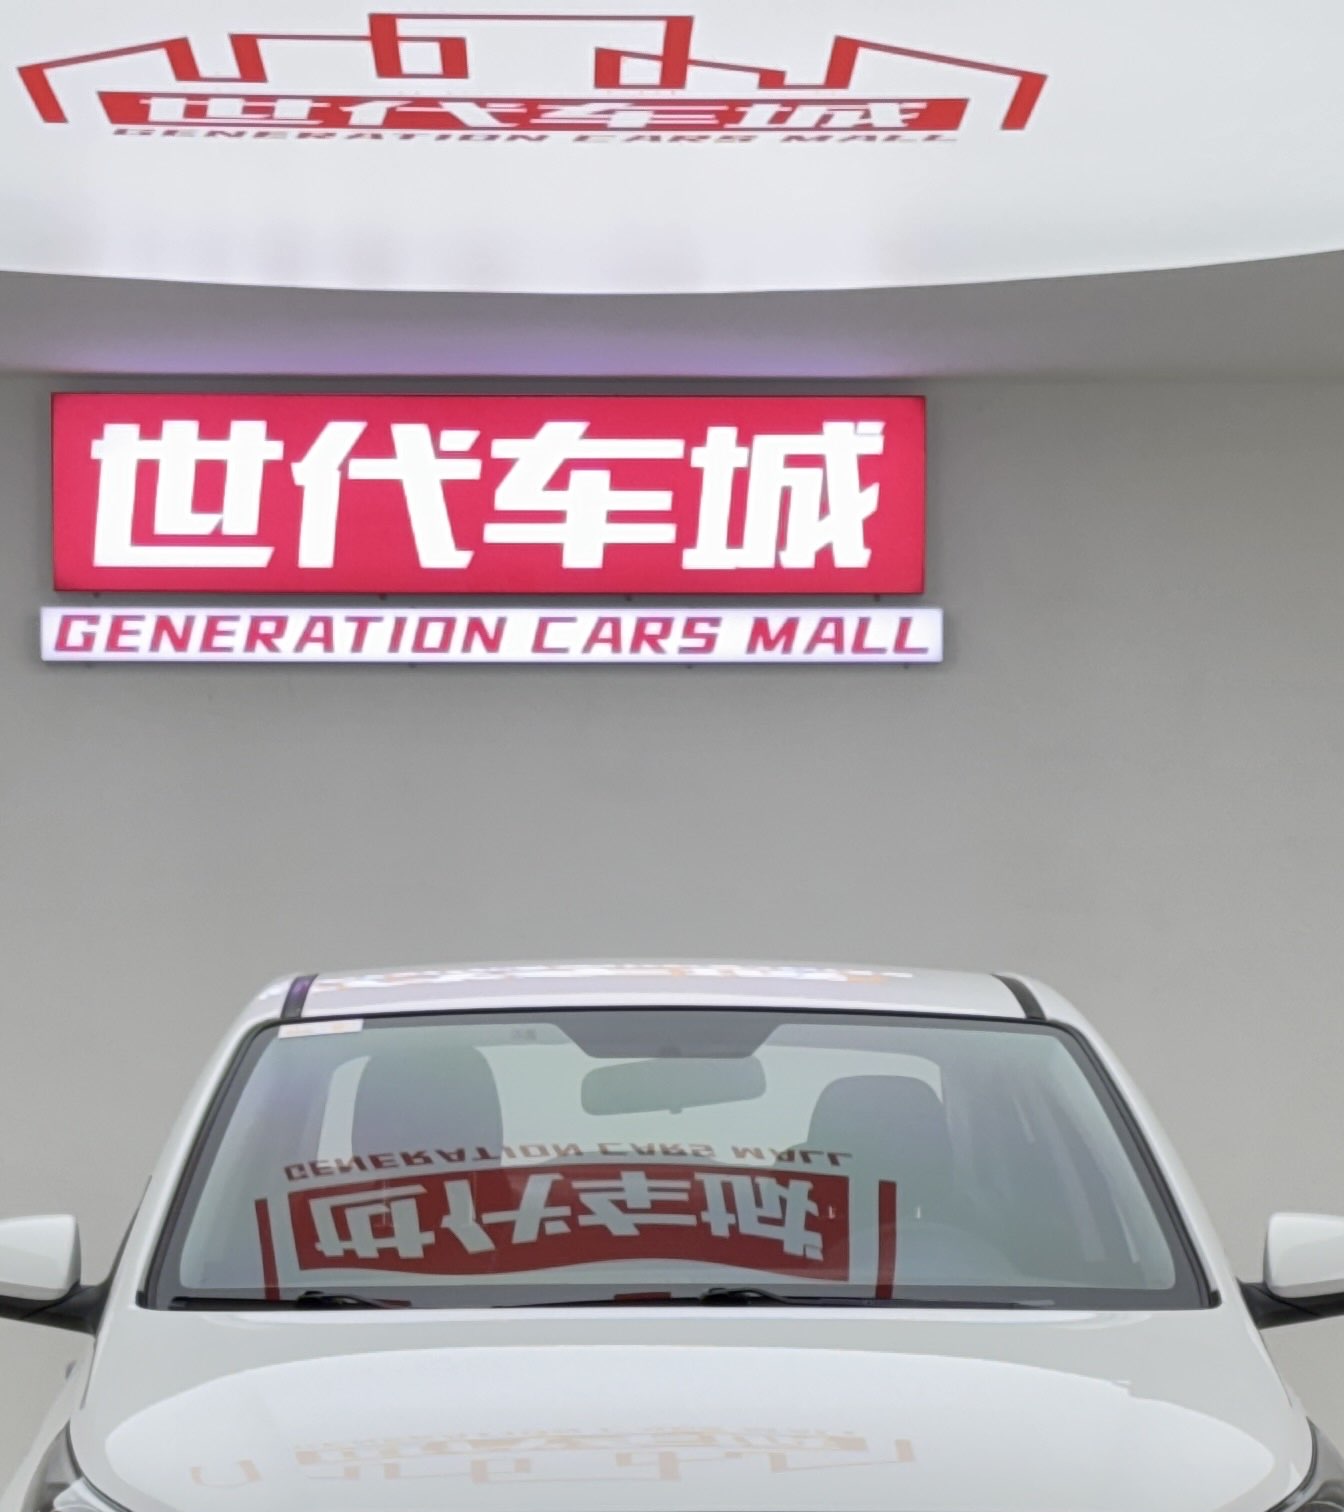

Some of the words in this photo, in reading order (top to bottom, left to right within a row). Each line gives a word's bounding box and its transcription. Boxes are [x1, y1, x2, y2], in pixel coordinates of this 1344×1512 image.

[90, 420, 885, 569] 世代车城
[54, 613, 510, 655] GENERATION
[530, 615, 723, 656] CARS
[746, 616, 931, 656] MALL
